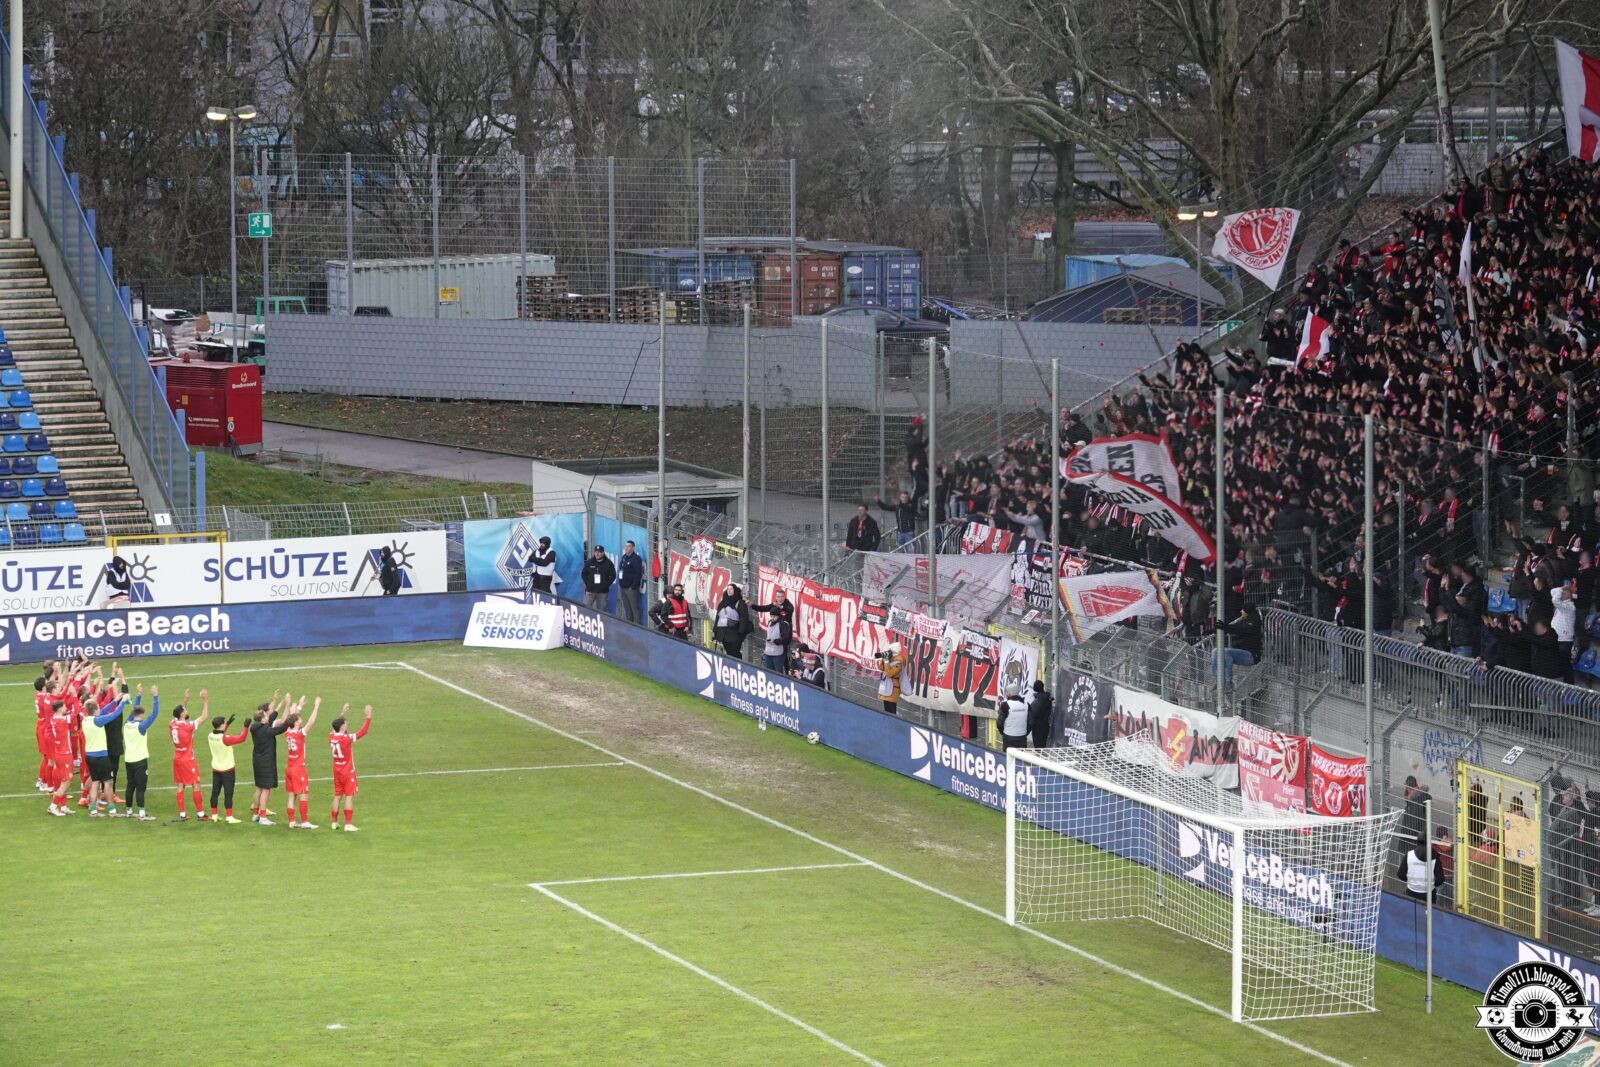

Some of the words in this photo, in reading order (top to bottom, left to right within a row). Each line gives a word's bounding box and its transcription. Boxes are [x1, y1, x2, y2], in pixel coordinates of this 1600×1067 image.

[160, 515, 166, 524] 1
[270, 581, 348, 598] SOLUTIONS
[518, 576, 531, 587] 07
[3, 595, 84, 611] SOLUTIONS
[14, 607, 230, 642] VeniceBeach
[476, 611, 539, 626] RECHNER
[481, 626, 544, 641] SENSORS
[56, 642, 115, 658] fitness
[120, 640, 153, 655] and
[159, 637, 230, 653] workout
[581, 640, 605, 658] workout
[714, 656, 799, 711] VeniceBeach
[730, 693, 753, 715] fitness
[755, 703, 769, 719] and
[770, 711, 799, 731] workout
[171, 728, 180, 744] 8
[1240, 720, 1272, 744] ENERGIE
[330, 742, 345, 758] 21
[1504, 747, 1523, 763] 25
[931, 733, 1036, 798] VeniceBech
[951, 775, 979, 799] fitness
[981, 789, 998, 806] and
